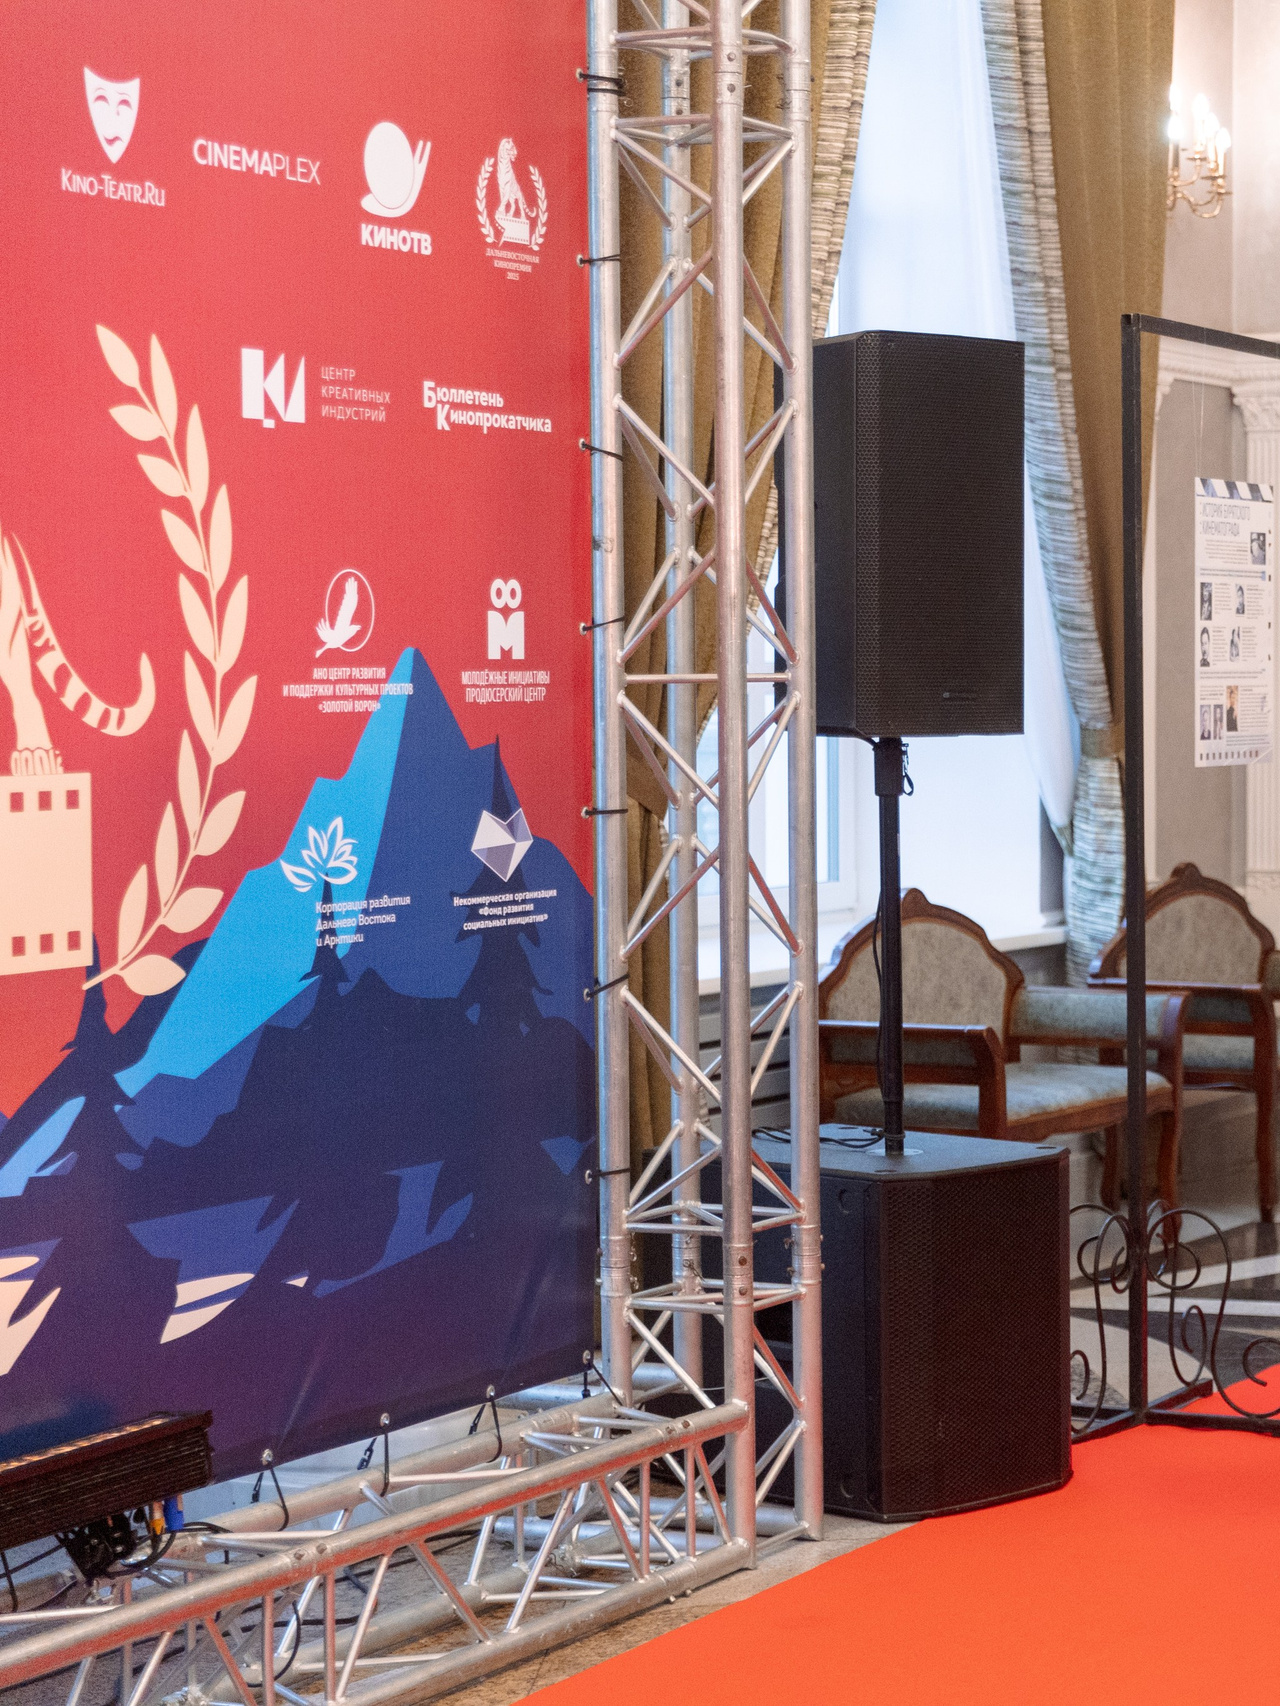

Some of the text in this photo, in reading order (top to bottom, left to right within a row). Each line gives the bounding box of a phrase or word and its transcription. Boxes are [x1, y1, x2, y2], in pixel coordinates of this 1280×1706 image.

[193, 139, 321, 186] CINEMAPLEX
[361, 224, 432, 256] КИНОТВ
[486, 248, 540, 264] ДАЛЬНЕВОСТОЧНАЯ
[494, 260, 532, 273] КИНОПРЕМИЯ
[321, 366, 356, 381] ЦЕНТР
[321, 386, 391, 404] КРЕАТИВНЫХ
[423, 381, 504, 408] Бюллетень
[321, 405, 386, 423] ИНДУСТРИЙ
[437, 403, 552, 434] Кинопрокатчика
[313, 667, 386, 681] АНО ЦЕНТР РАЗВИТИЯ
[462, 669, 550, 686] МОЛОДЁЖНЫЕ ИНИЦИАТИВЫ
[283, 683, 414, 698] И ПОДДЕРЖКИ КУЛЬТУРНЫХ ПРОЕКТОВ
[466, 686, 546, 704] ПРОДЮСЕРСКИЙ ЦЕНТР
[316, 895, 410, 916] Корпорация развития
[454, 889, 557, 906] Некоммерческая организация
[503, 903, 534, 916] развития
[316, 914, 396, 932] Дальнего Востока
[463, 918, 506, 930] социальных
[324, 934, 364, 949] Арктики
